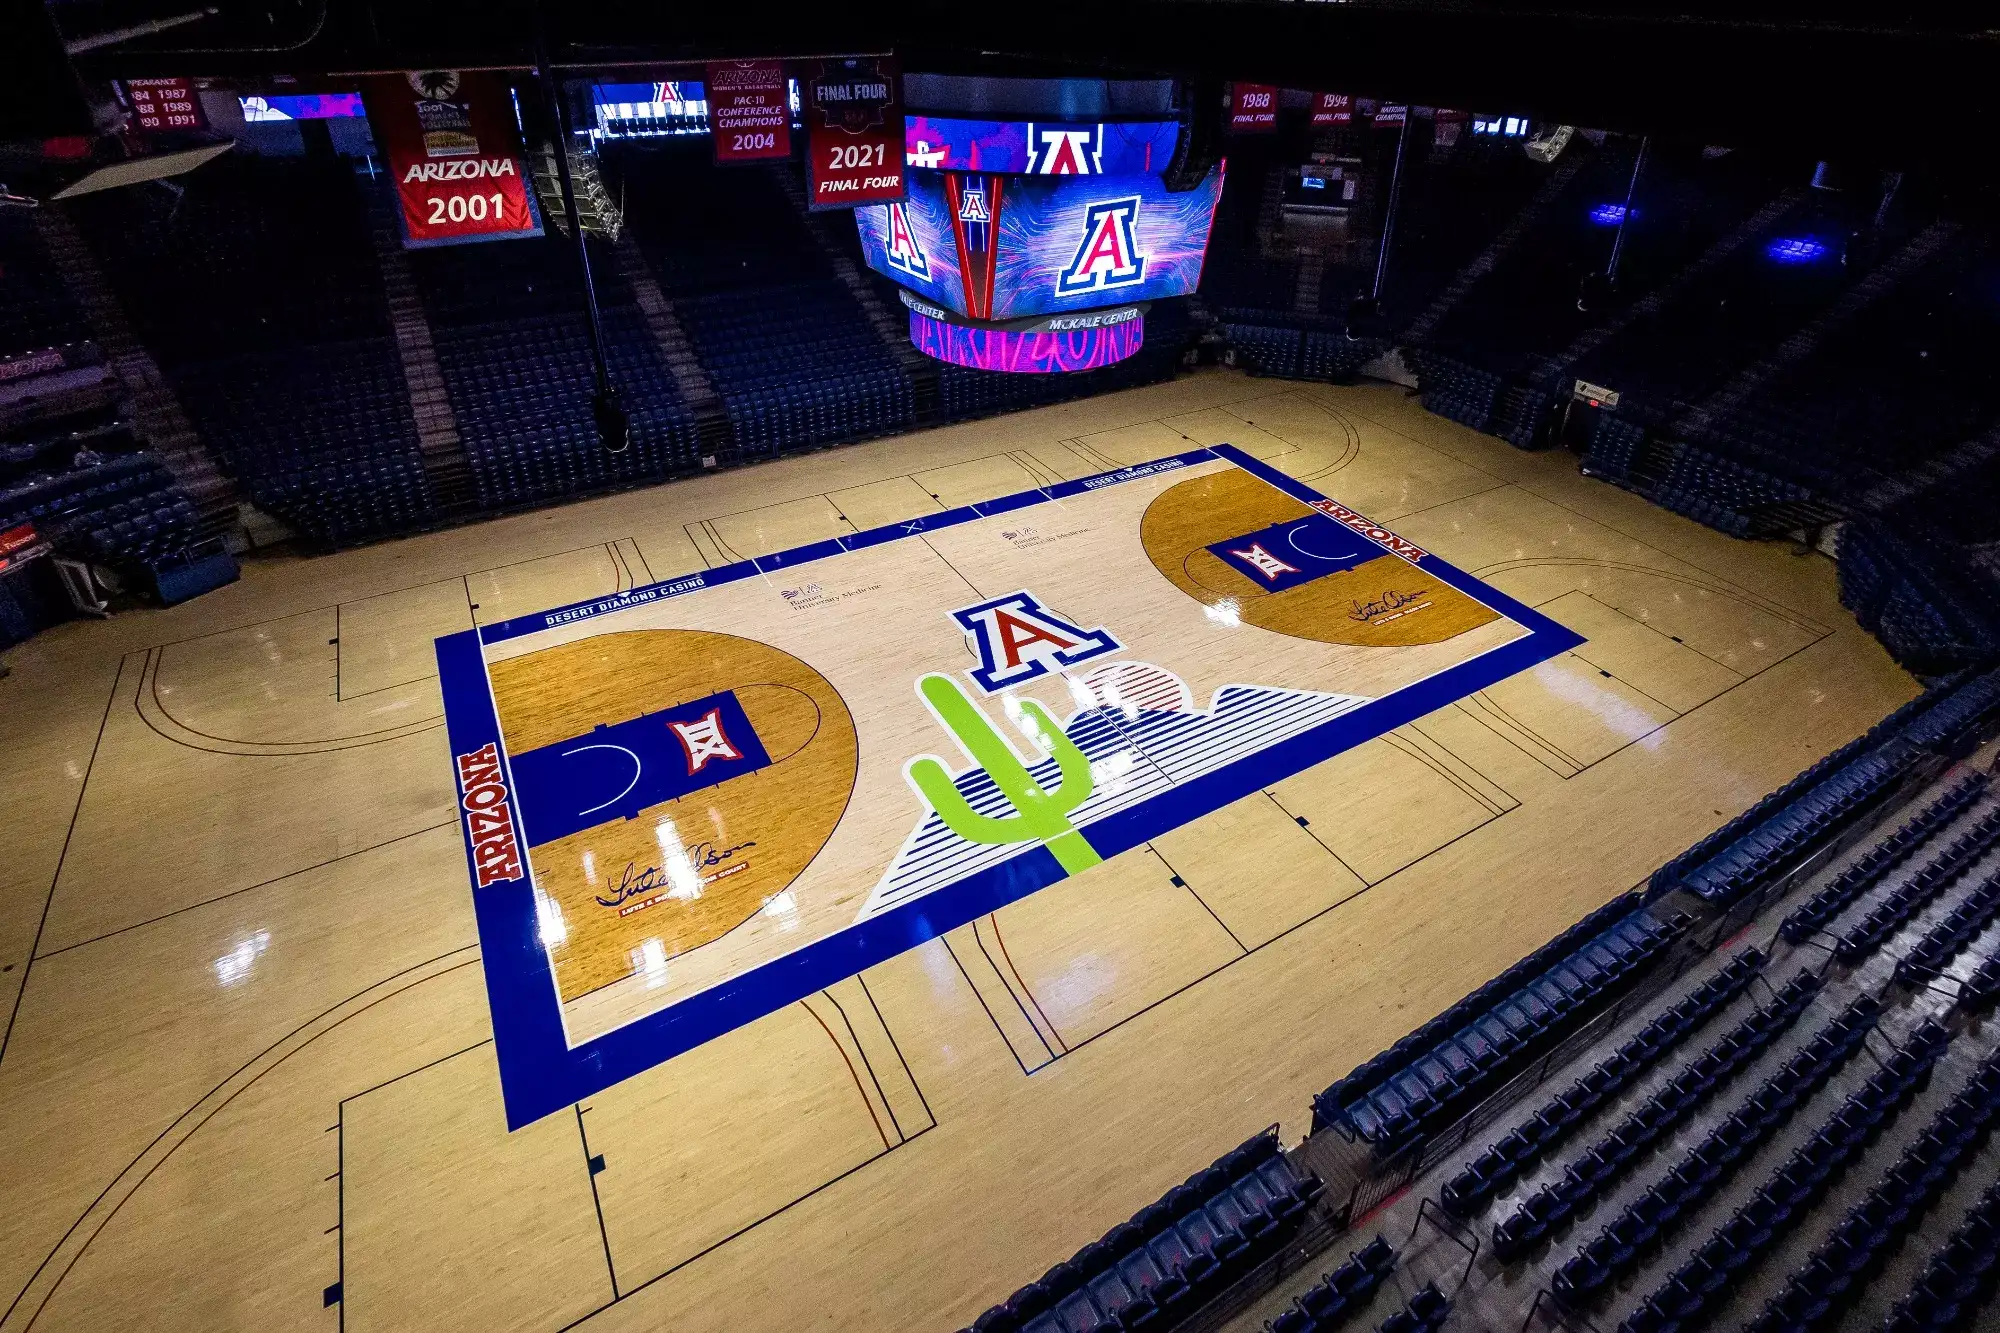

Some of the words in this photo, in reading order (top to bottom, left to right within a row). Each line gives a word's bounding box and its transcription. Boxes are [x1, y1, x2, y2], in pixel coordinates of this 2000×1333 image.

[712, 69, 783, 86] ARIZONA
[157, 89, 187, 99] 1987
[734, 95, 765, 106] PAC-10
[816, 84, 853, 102] FINAL
[854, 83, 887, 100] FOUR
[1242, 93, 1271, 109] 1988
[1323, 94, 1348, 108] 1994
[162, 102, 192, 112] 1989
[717, 105, 782, 117] CONFERENCE
[168, 115, 195, 125] 1991
[719, 116, 784, 129] CHAMPIONS
[1233, 113, 1254, 123] FINAL
[1255, 113, 1275, 122] FOUR
[732, 133, 775, 151] 2004
[829, 143, 885, 170] 2021
[403, 158, 515, 184] ARIZONA
[819, 179, 860, 193] FINAL
[862, 175, 900, 190] FOUR
[427, 193, 504, 225] 2001
[1054, 194, 1148, 298] A
[913, 302, 945, 321] CENTER
[1101, 308, 1138, 326] CENTER
[1085, 477, 1115, 488] DESERT
[1116, 469, 1153, 480] DIAMOND
[1154, 460, 1184, 472] CASINO
[1308, 499, 1430, 562] ARIZONA
[546, 607, 594, 626] DESERT
[598, 592, 657, 612] DIAMOND
[660, 579, 705, 596] CASINO
[944, 588, 1129, 698] A
[456, 742, 524, 889] ARIZONA
